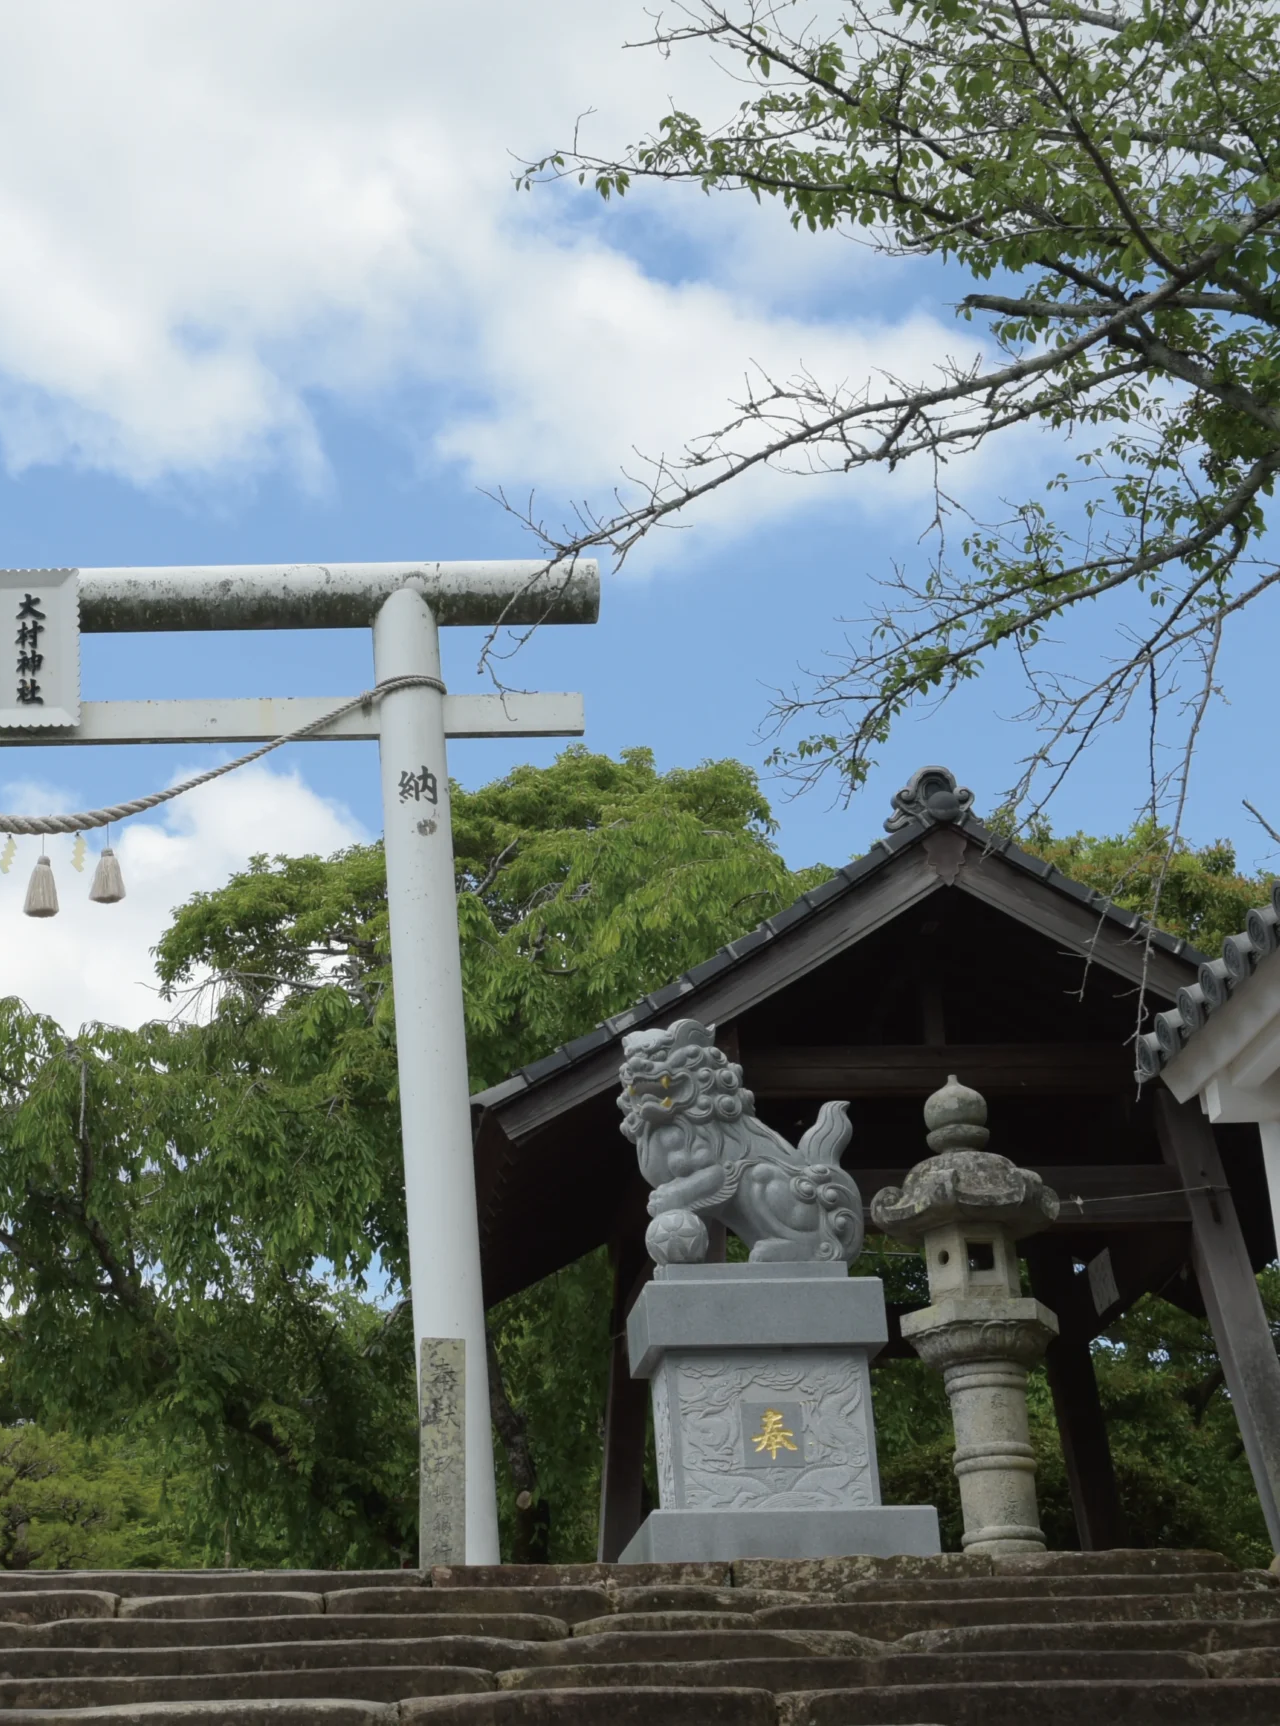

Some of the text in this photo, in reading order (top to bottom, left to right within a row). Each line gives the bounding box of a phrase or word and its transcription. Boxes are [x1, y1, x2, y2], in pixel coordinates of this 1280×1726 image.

[15, 593, 46, 705] 大村神社
[398, 765, 438, 805] 納
[751, 1408, 798, 1460] 奉
